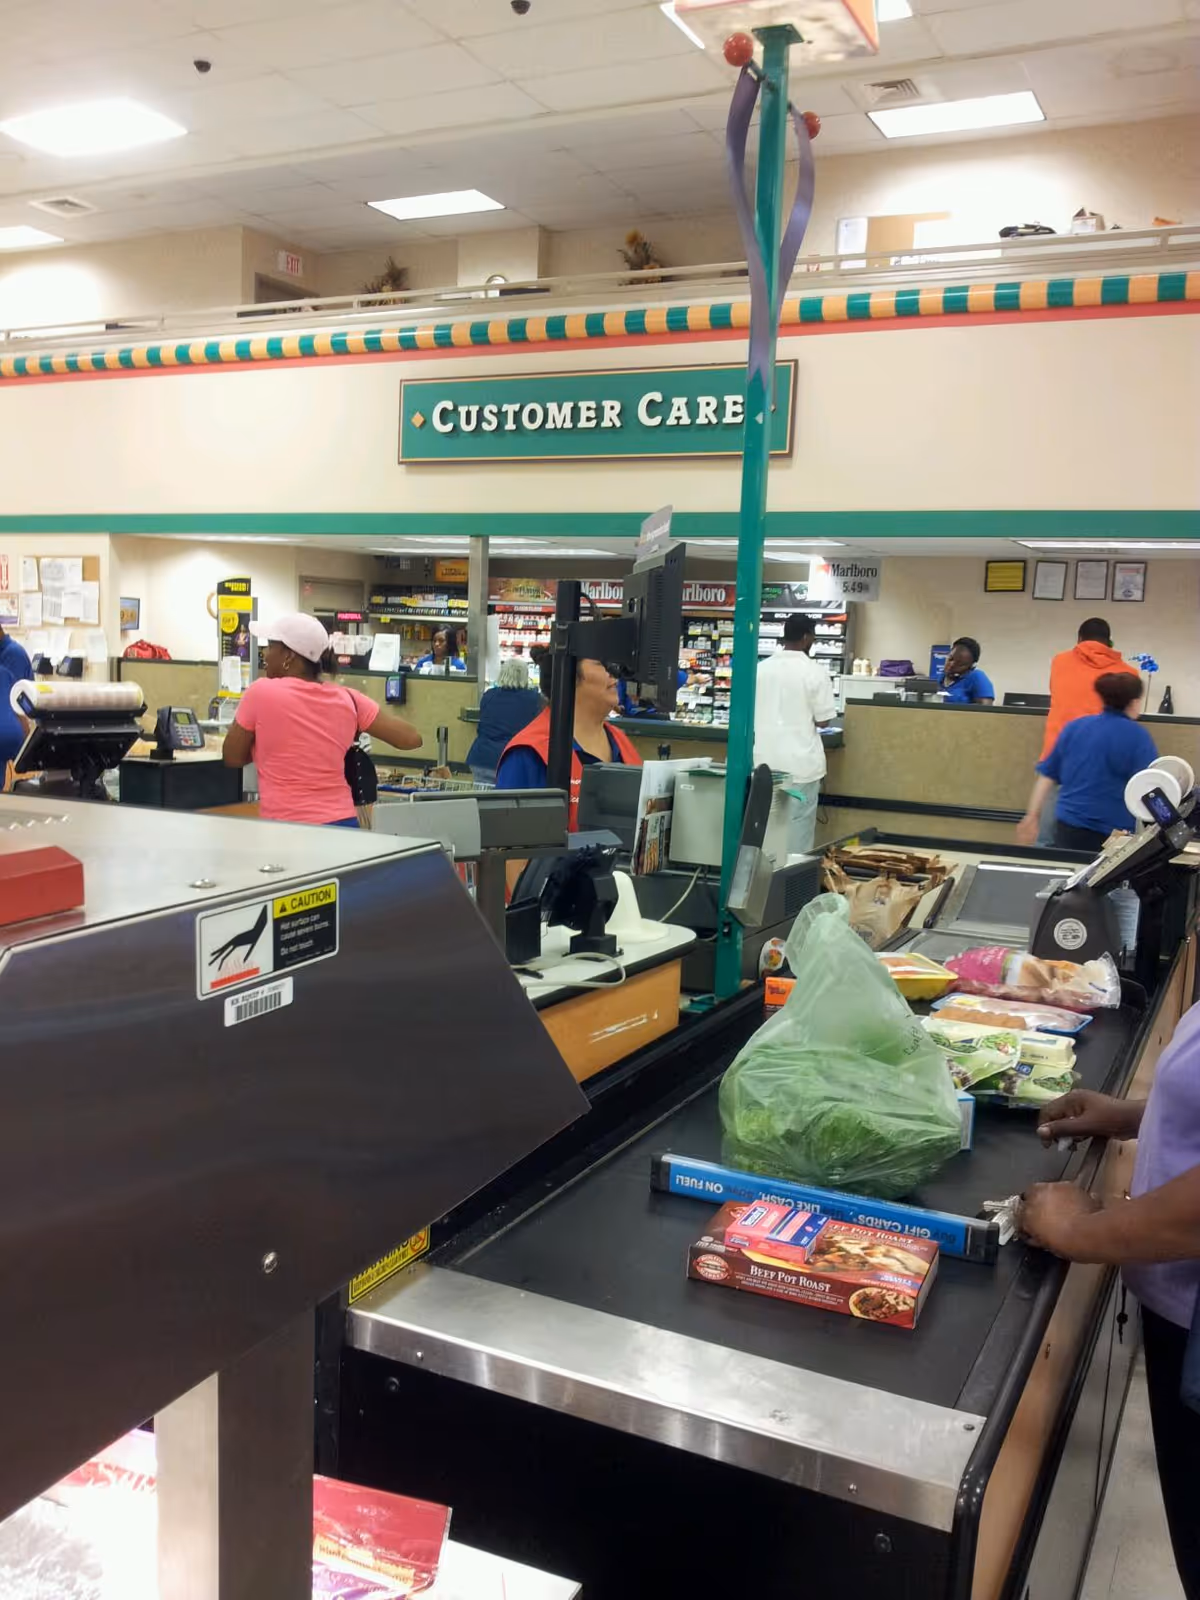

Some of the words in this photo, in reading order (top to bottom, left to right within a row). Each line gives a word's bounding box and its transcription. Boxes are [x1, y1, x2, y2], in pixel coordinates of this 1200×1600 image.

[432, 399, 622, 433] CUSTOMER
[637, 391, 744, 427] CARE
[831, 563, 878, 578] Marlboro
[290, 888, 332, 910] CAUTION
[675, 1173, 704, 1190] FUEL!
[704, 1179, 723, 1194] ON
[795, 1199, 821, 1214] LIKE
[851, 1227, 874, 1237] POT
[876, 1232, 914, 1245] ROAST
[903, 1223, 931, 1239] GIFT
[750, 1265, 775, 1280] BEEF
[777, 1270, 798, 1283] POT
[799, 1276, 831, 1293] ROAST
